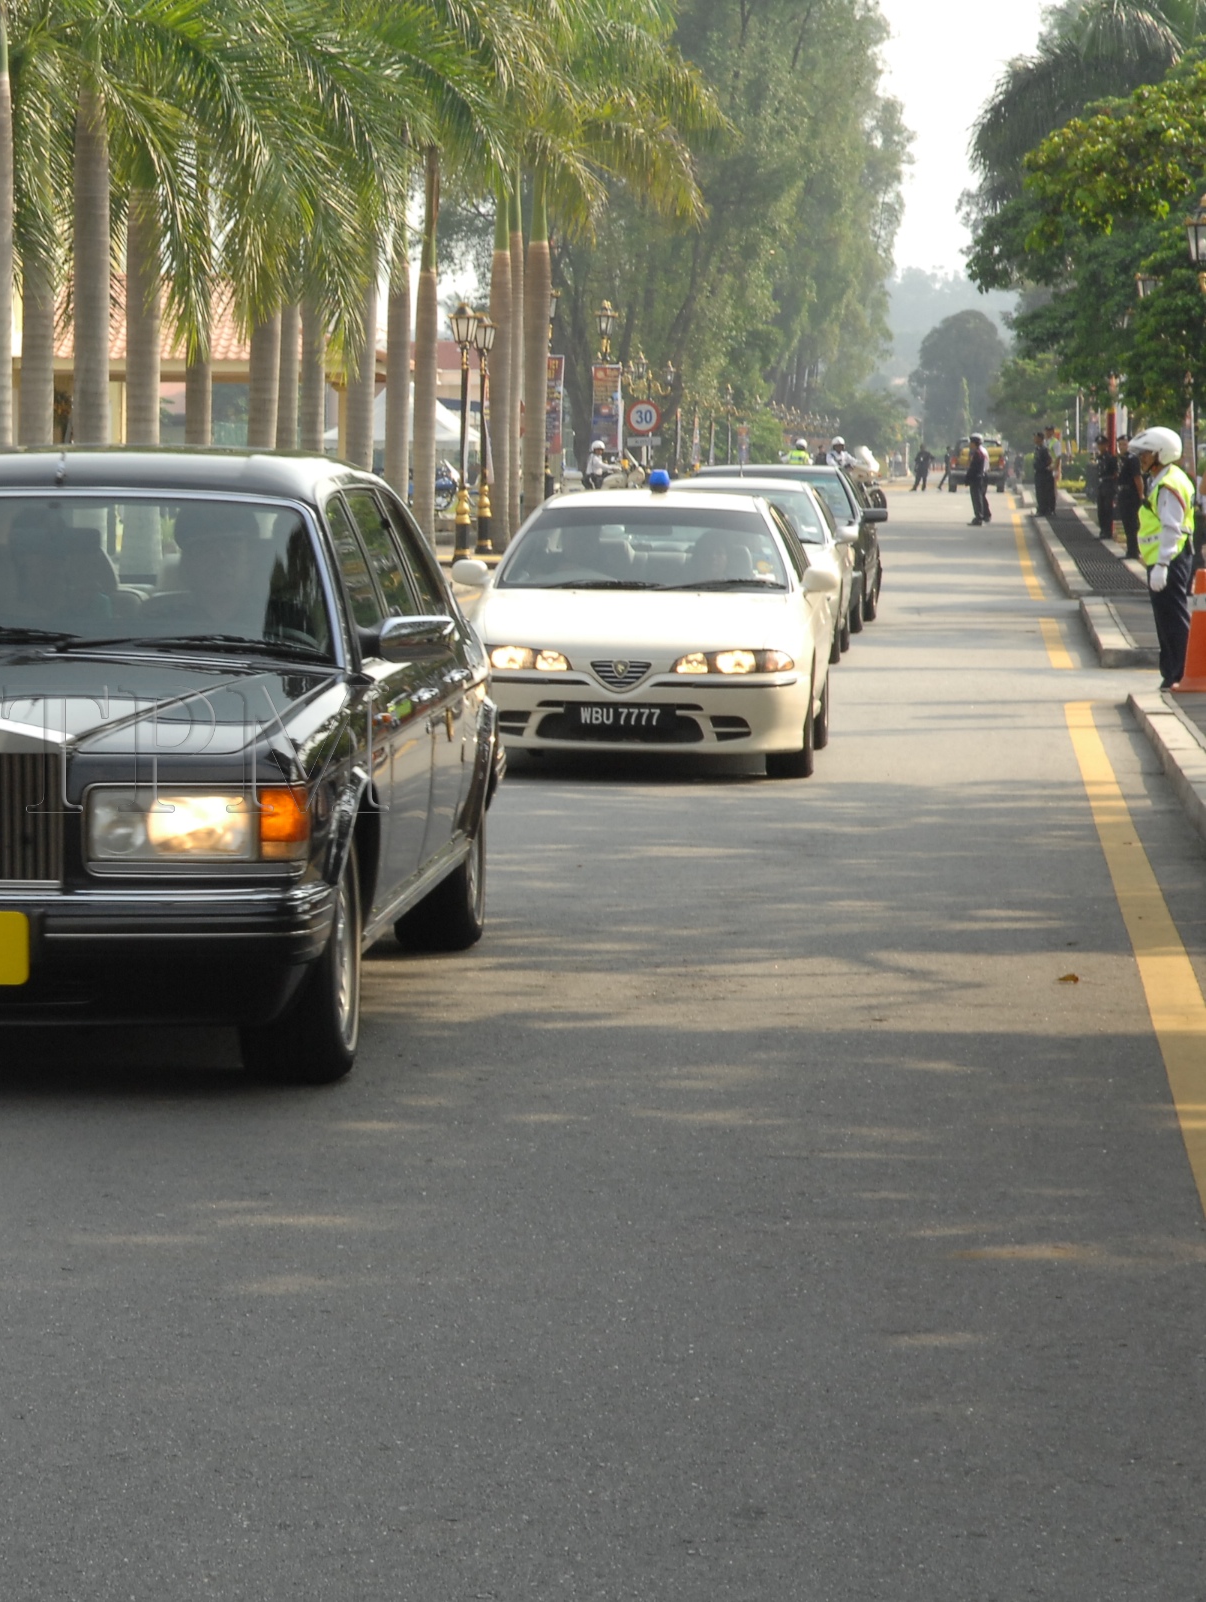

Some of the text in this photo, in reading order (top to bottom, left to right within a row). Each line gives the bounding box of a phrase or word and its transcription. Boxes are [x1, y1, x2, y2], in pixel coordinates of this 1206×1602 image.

[635, 409, 653, 425] 30
[580, 706, 661, 726] WBU 7777
